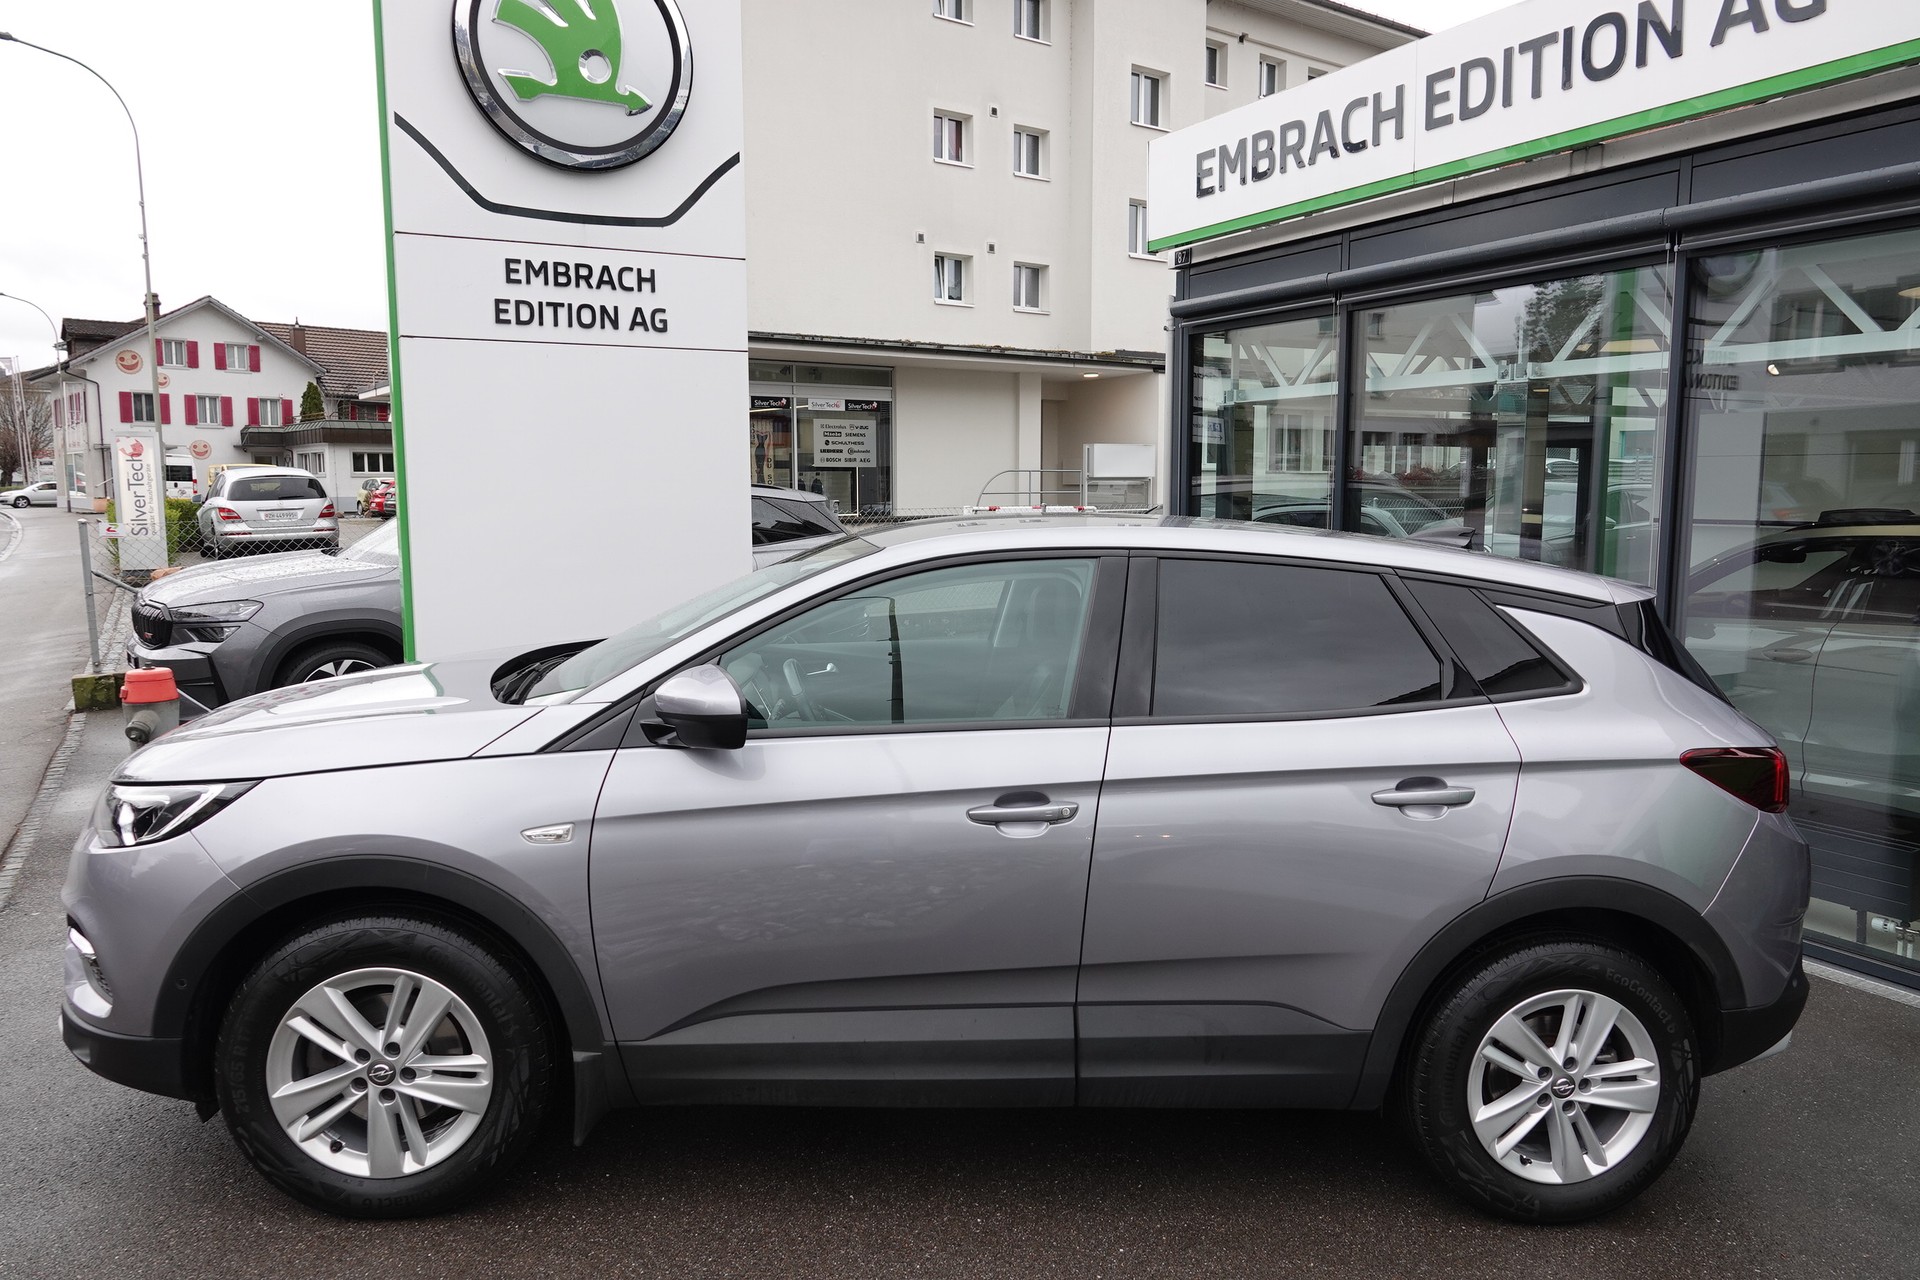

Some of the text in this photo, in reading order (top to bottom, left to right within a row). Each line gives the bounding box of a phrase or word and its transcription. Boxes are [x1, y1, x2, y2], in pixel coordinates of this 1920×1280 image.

[1196, 83, 1405, 198] EMBRACH
[1425, 0, 1683, 131] EDITION
[505, 257, 656, 293] EMBRACH
[1177, 251, 1187, 264] 87
[494, 298, 668, 333] EDITION AG
[1604, 966, 1674, 1026] EcoContact
